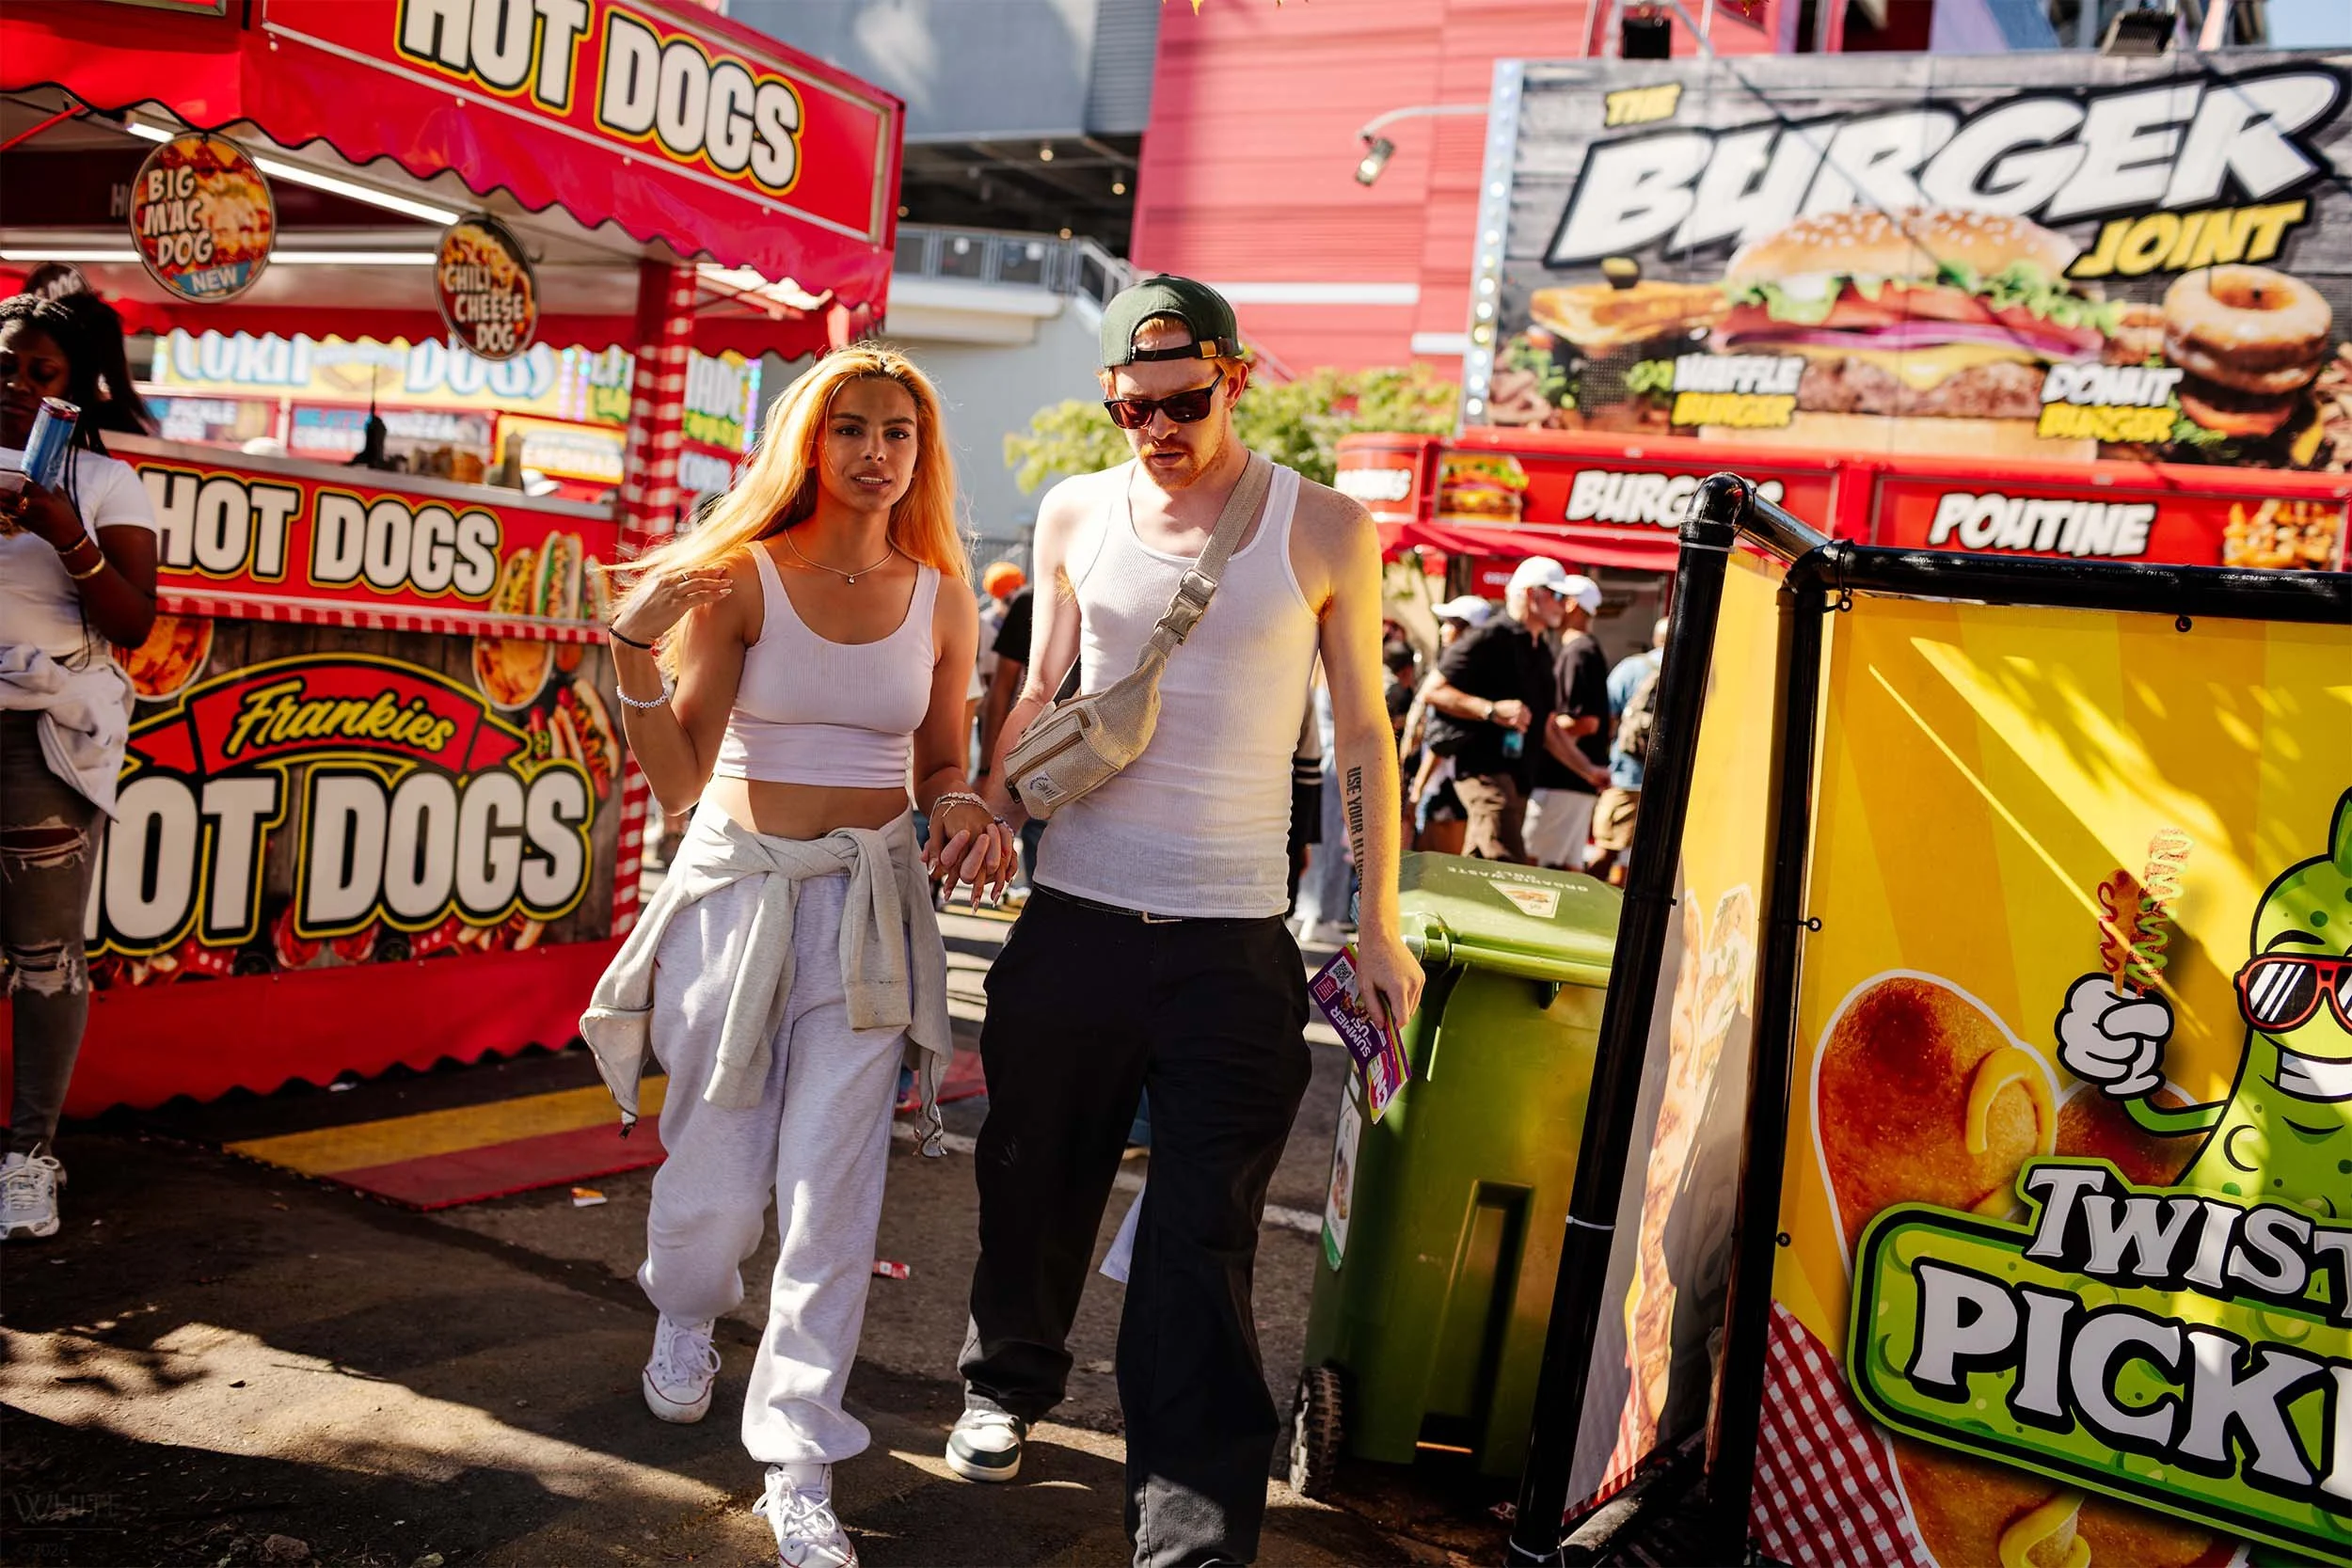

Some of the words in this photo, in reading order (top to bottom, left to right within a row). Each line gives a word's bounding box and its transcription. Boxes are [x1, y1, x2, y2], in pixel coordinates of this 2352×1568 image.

[399, 0, 587, 110] HOT
[599, 12, 800, 189] DOGS
[1604, 82, 1683, 127] THE
[148, 166, 195, 200] BIG
[1546, 71, 2339, 265] BURGER
[143, 199, 202, 235] MAC
[2066, 198, 2308, 278] JOINT
[157, 230, 213, 267] DOG
[191, 266, 238, 293] NEW
[444, 263, 490, 293] CHILI
[454, 292, 524, 323] CHEESE
[475, 323, 516, 352] DOG
[1674, 353, 1804, 393] WAFFLE
[2040, 361, 2185, 405] DONUT
[1565, 470, 1784, 529] BURG
[141, 470, 299, 577] HOT
[312, 492, 498, 596] DOGS
[1929, 493, 2156, 557] POUTINE
[227, 681, 455, 753] Frankies
[1346, 766, 1361, 796] USE
[1347, 799, 1363, 835] YOUR
[85, 775, 276, 939] OT
[307, 769, 585, 923] DOGS
[1329, 1005, 1372, 1058] SUMMER
